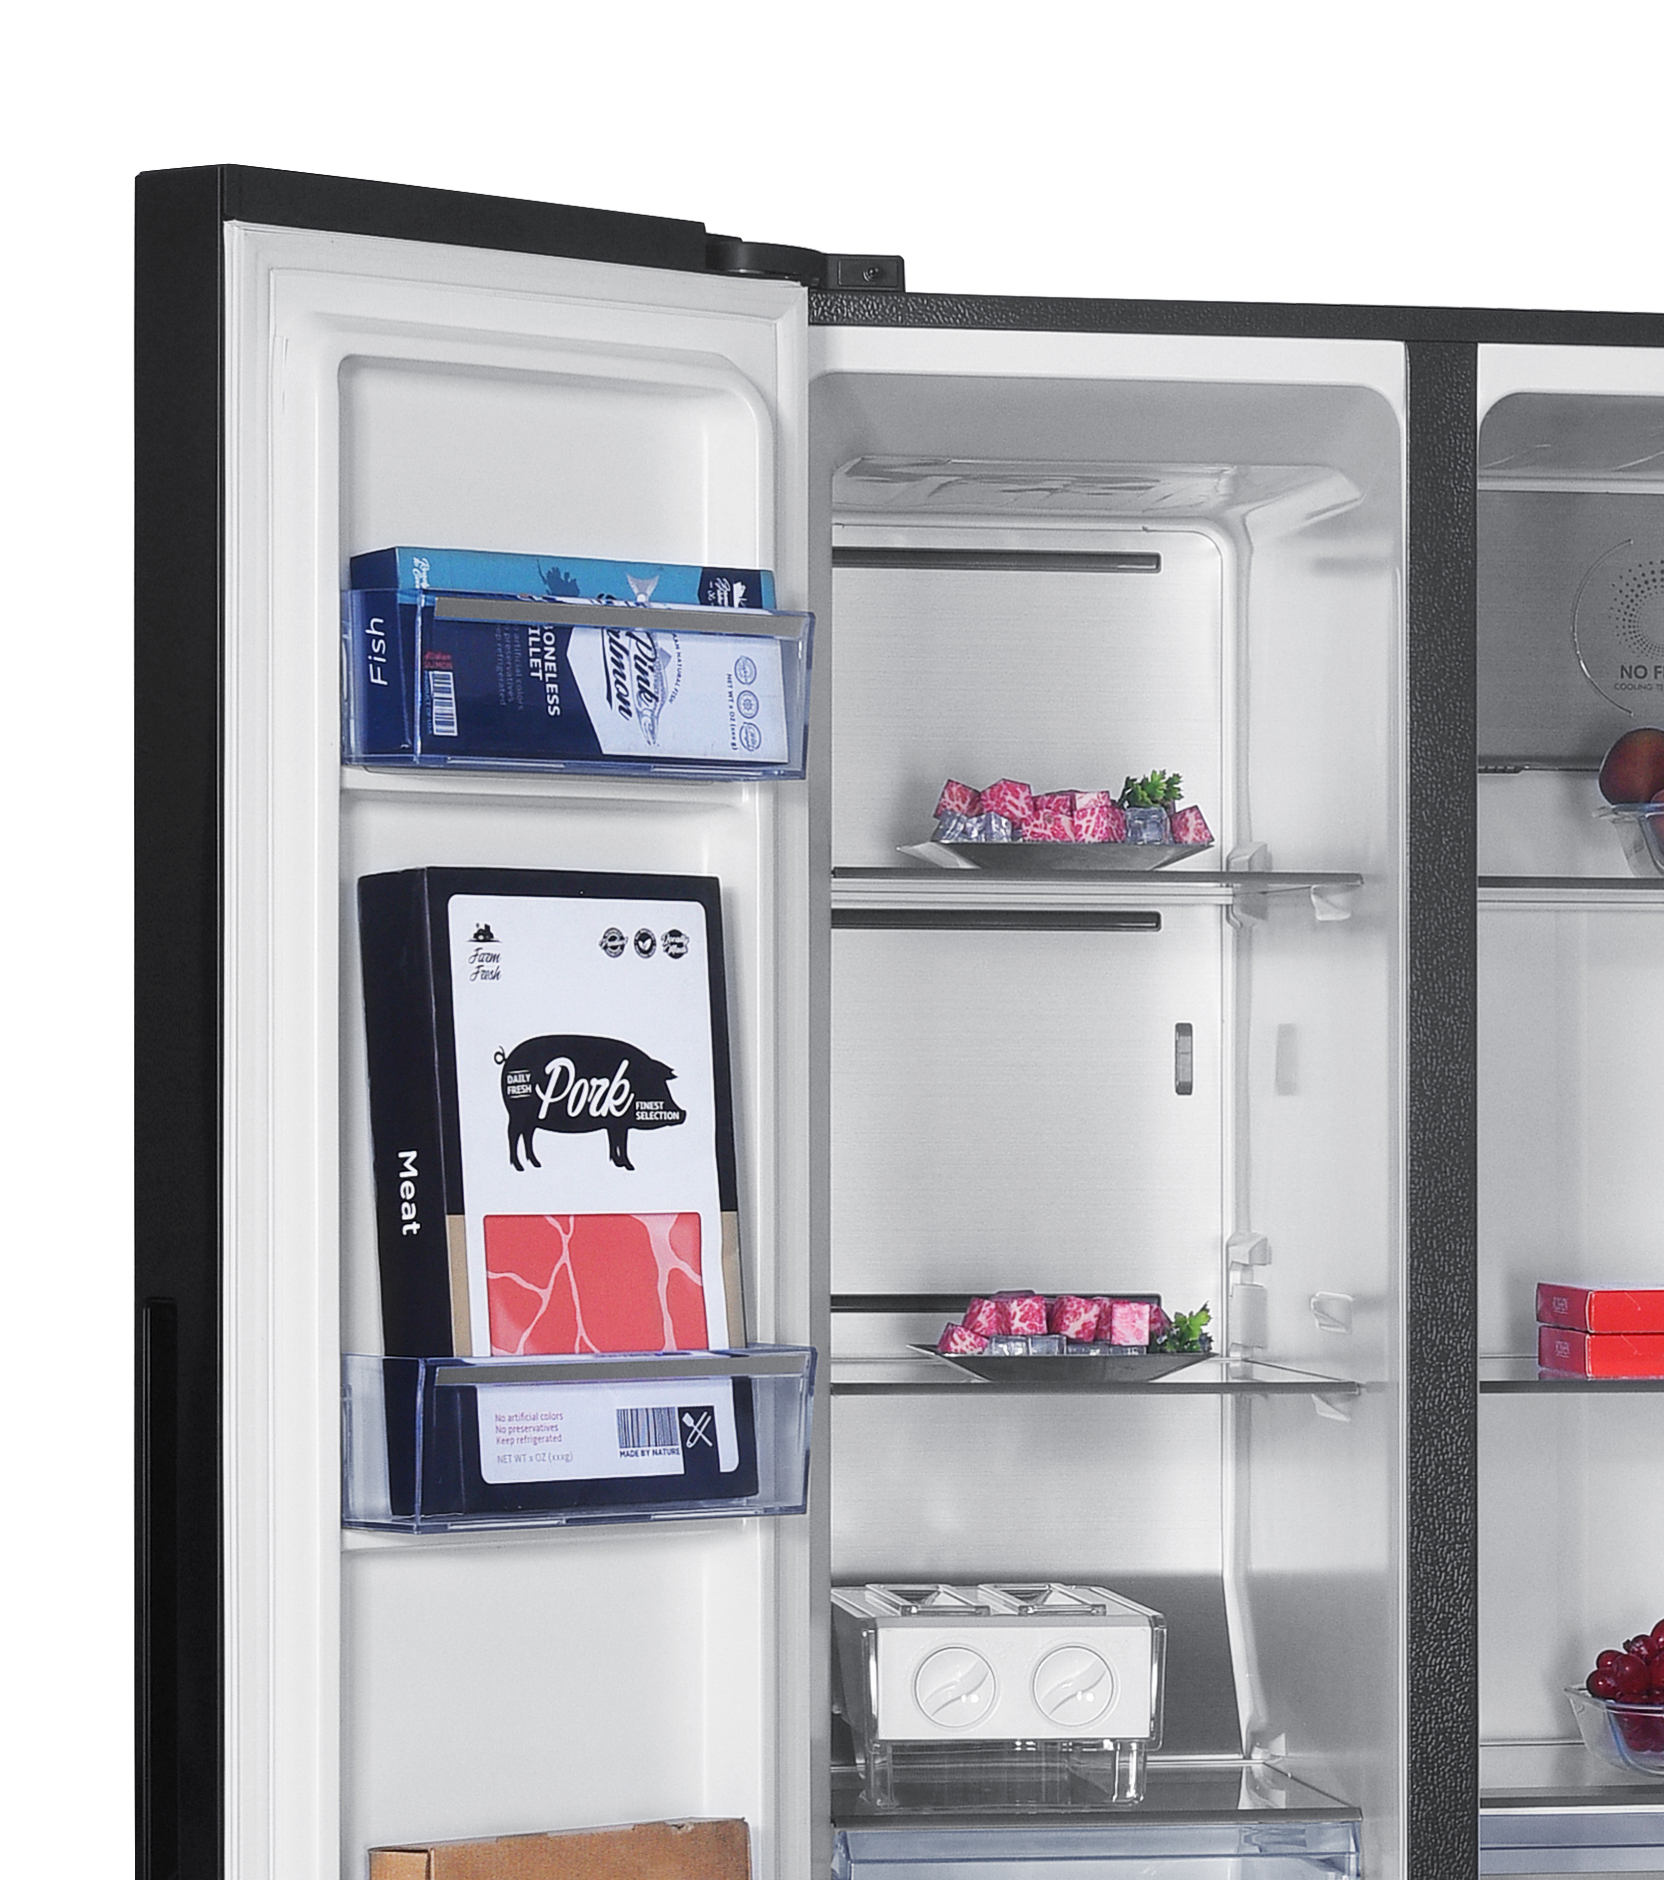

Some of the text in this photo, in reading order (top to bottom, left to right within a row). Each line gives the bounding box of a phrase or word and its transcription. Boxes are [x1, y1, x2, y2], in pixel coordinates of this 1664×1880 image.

[365, 617, 388, 686] Fish
[527, 625, 543, 682] ILLET
[503, 632, 514, 703] preservatives
[513, 632, 525, 711] artificial colors
[605, 628, 633, 722] almon
[624, 631, 659, 708] Pink
[674, 651, 682, 688] NATURAL
[1620, 664, 1648, 680] NO
[1613, 683, 1653, 692] COOLING
[468, 947, 502, 965] Farm
[469, 965, 502, 982] Fresh
[506, 1072, 532, 1085] DAILY
[507, 1084, 533, 1096] FRESH
[535, 1056, 635, 1120] Pork
[635, 1101, 665, 1111] FINEST
[635, 1110, 680, 1121] SELECTION
[398, 1150, 420, 1236] Meat
[495, 1410, 564, 1422] No artificial colors
[496, 1421, 559, 1435] No preservatives
[496, 1433, 562, 1447] Keep refrigerated
[497, 1453, 512, 1464] NET
[515, 1453, 527, 1463] WT
[535, 1451, 547, 1462] OZ
[619, 1447, 681, 1459] MADE BY NATURE
